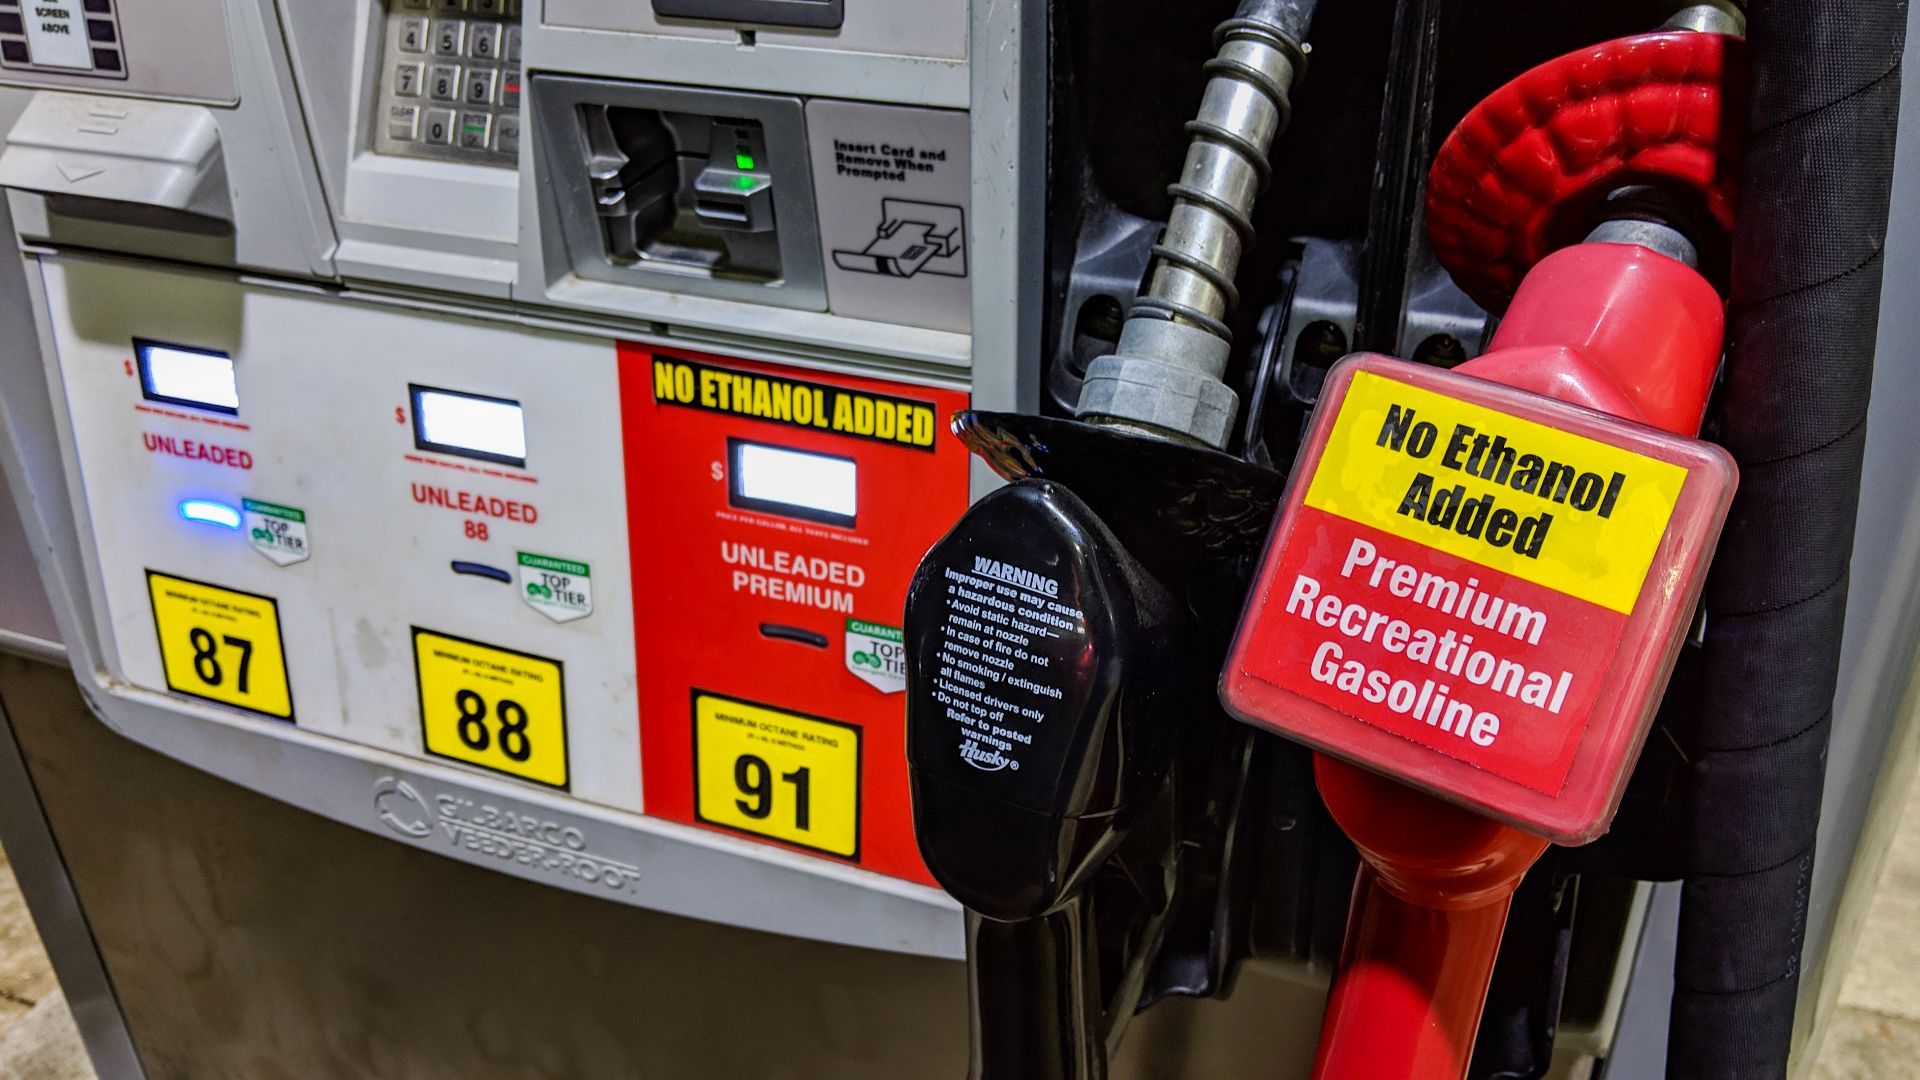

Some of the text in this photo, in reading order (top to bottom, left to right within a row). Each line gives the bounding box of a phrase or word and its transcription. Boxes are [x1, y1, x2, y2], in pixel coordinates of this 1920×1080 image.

[35, 7, 70, 19] SCREEN
[42, 23, 70, 34] ABOVE
[406, 31, 415, 47] 4
[442, 35, 452, 50] 5
[479, 37, 489, 53] 6
[402, 75, 412, 90] 7
[474, 83, 483, 98] 9
[432, 123, 442, 138] 0
[834, 140, 946, 161] Insert Card and
[835, 152, 934, 172] Remove When
[837, 164, 906, 182] Prompted
[395, 407, 406, 424] $
[654, 361, 934, 447] NO ETHANOL ADDED
[142, 432, 253, 470] UNLEADED
[1376, 403, 1626, 519] No Ethanol
[711, 461, 723, 481] $
[411, 482, 538, 525] UNLEADED
[1397, 472, 1553, 560] Added
[264, 518, 288, 534] TOP
[464, 519, 490, 541] 88
[277, 535, 303, 549] TIER
[721, 541, 865, 588] UNLEADED
[972, 555, 1059, 598] WARNING
[541, 573, 571, 589] TOP
[733, 570, 854, 614] PREMIUM
[945, 567, 1084, 619] Improper use may cause
[1340, 537, 1547, 645] Premium
[554, 590, 588, 606] TIER
[948, 585, 1074, 631] a hazardous condition
[951, 599, 980, 616] Avoid
[981, 608, 1009, 625] static
[851, 621, 904, 640] GUARANT
[949, 614, 1029, 646] remain at nozzle
[1286, 574, 1573, 714] Recreational
[190, 627, 253, 694] 87
[870, 640, 904, 659] TOP
[944, 640, 1015, 671] remove nozzle
[946, 626, 1049, 667] In case of fire do not
[883, 658, 906, 675] TIE
[940, 667, 986, 690] all flames
[942, 652, 956, 665] No
[957, 659, 1000, 682] smoking
[1008, 675, 1063, 700] extinguish
[937, 692, 1004, 723] Do not top off
[939, 679, 1045, 723] Licensed drivers only
[1310, 641, 1500, 747] Gasoline
[455, 688, 531, 763] 88
[715, 712, 757, 728] MINIMUM
[759, 723, 799, 739] OCTANE
[802, 732, 839, 748] RATING
[947, 708, 1032, 745] Refer to posted
[961, 727, 1012, 751] warnings
[734, 753, 810, 832] 91
[436, 794, 586, 851] GILBARCO
[438, 821, 641, 893] VEEDER-ROOT
